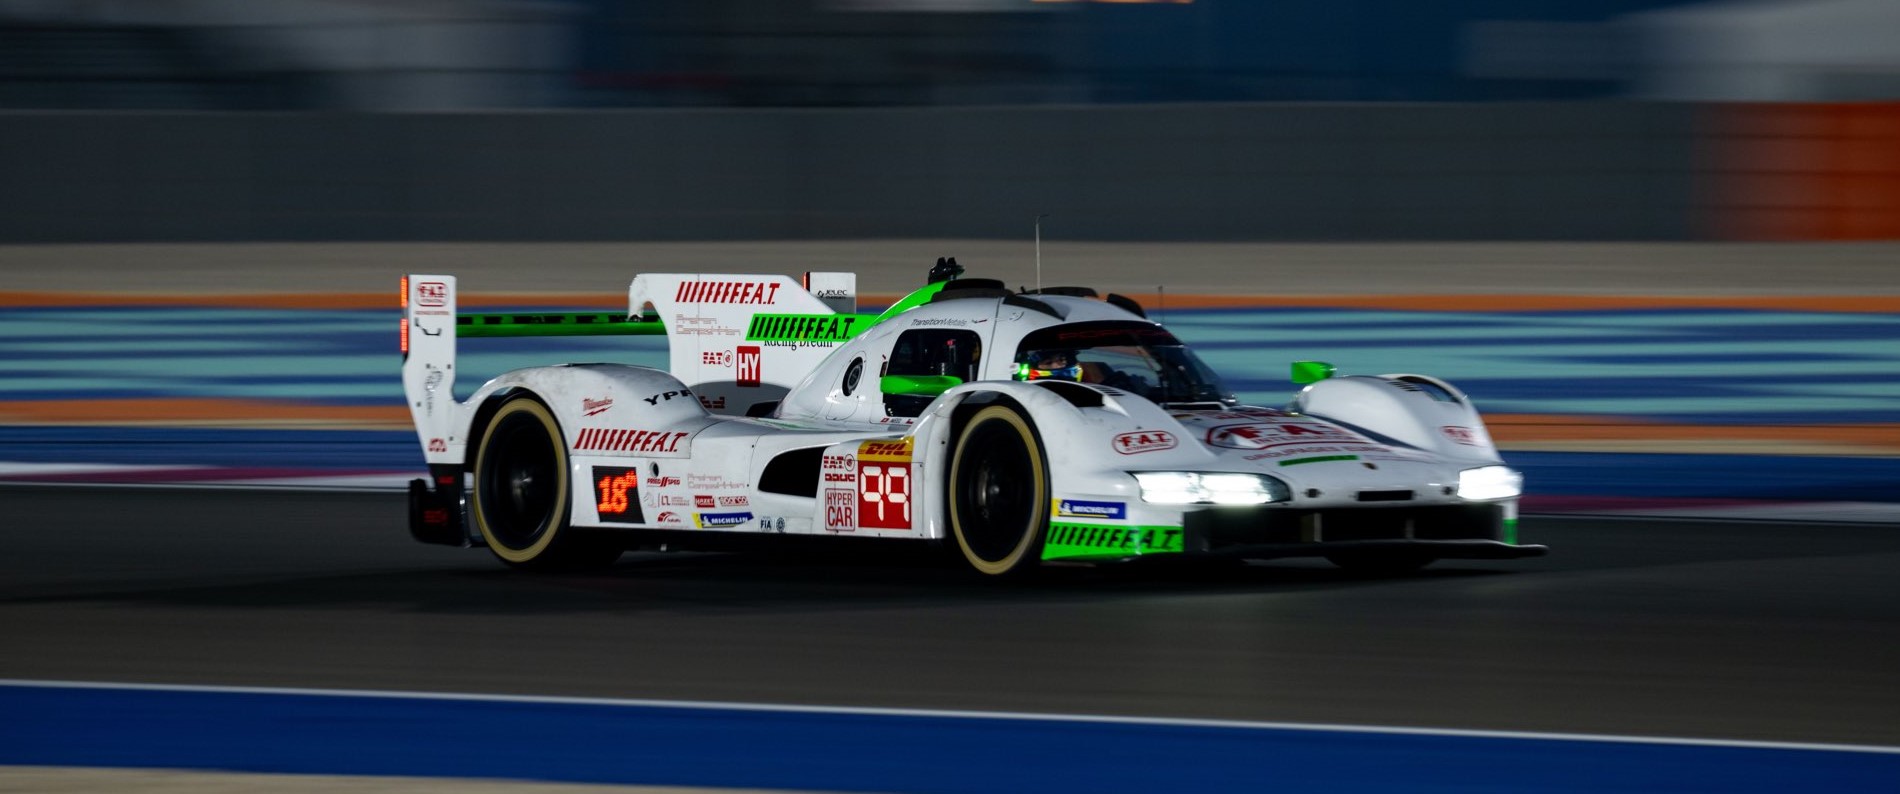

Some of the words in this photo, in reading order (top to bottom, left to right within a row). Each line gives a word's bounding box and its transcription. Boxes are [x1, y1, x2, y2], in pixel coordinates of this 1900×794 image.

[737, 353, 760, 381] HY
[865, 442, 908, 456] DHL
[827, 491, 853, 506] HYPER
[860, 466, 910, 523] 99
[827, 505, 854, 527] CAR
[1071, 504, 1120, 515] MICHELIN
[711, 516, 748, 524] MICHELIN
[760, 518, 772, 529] FIA
